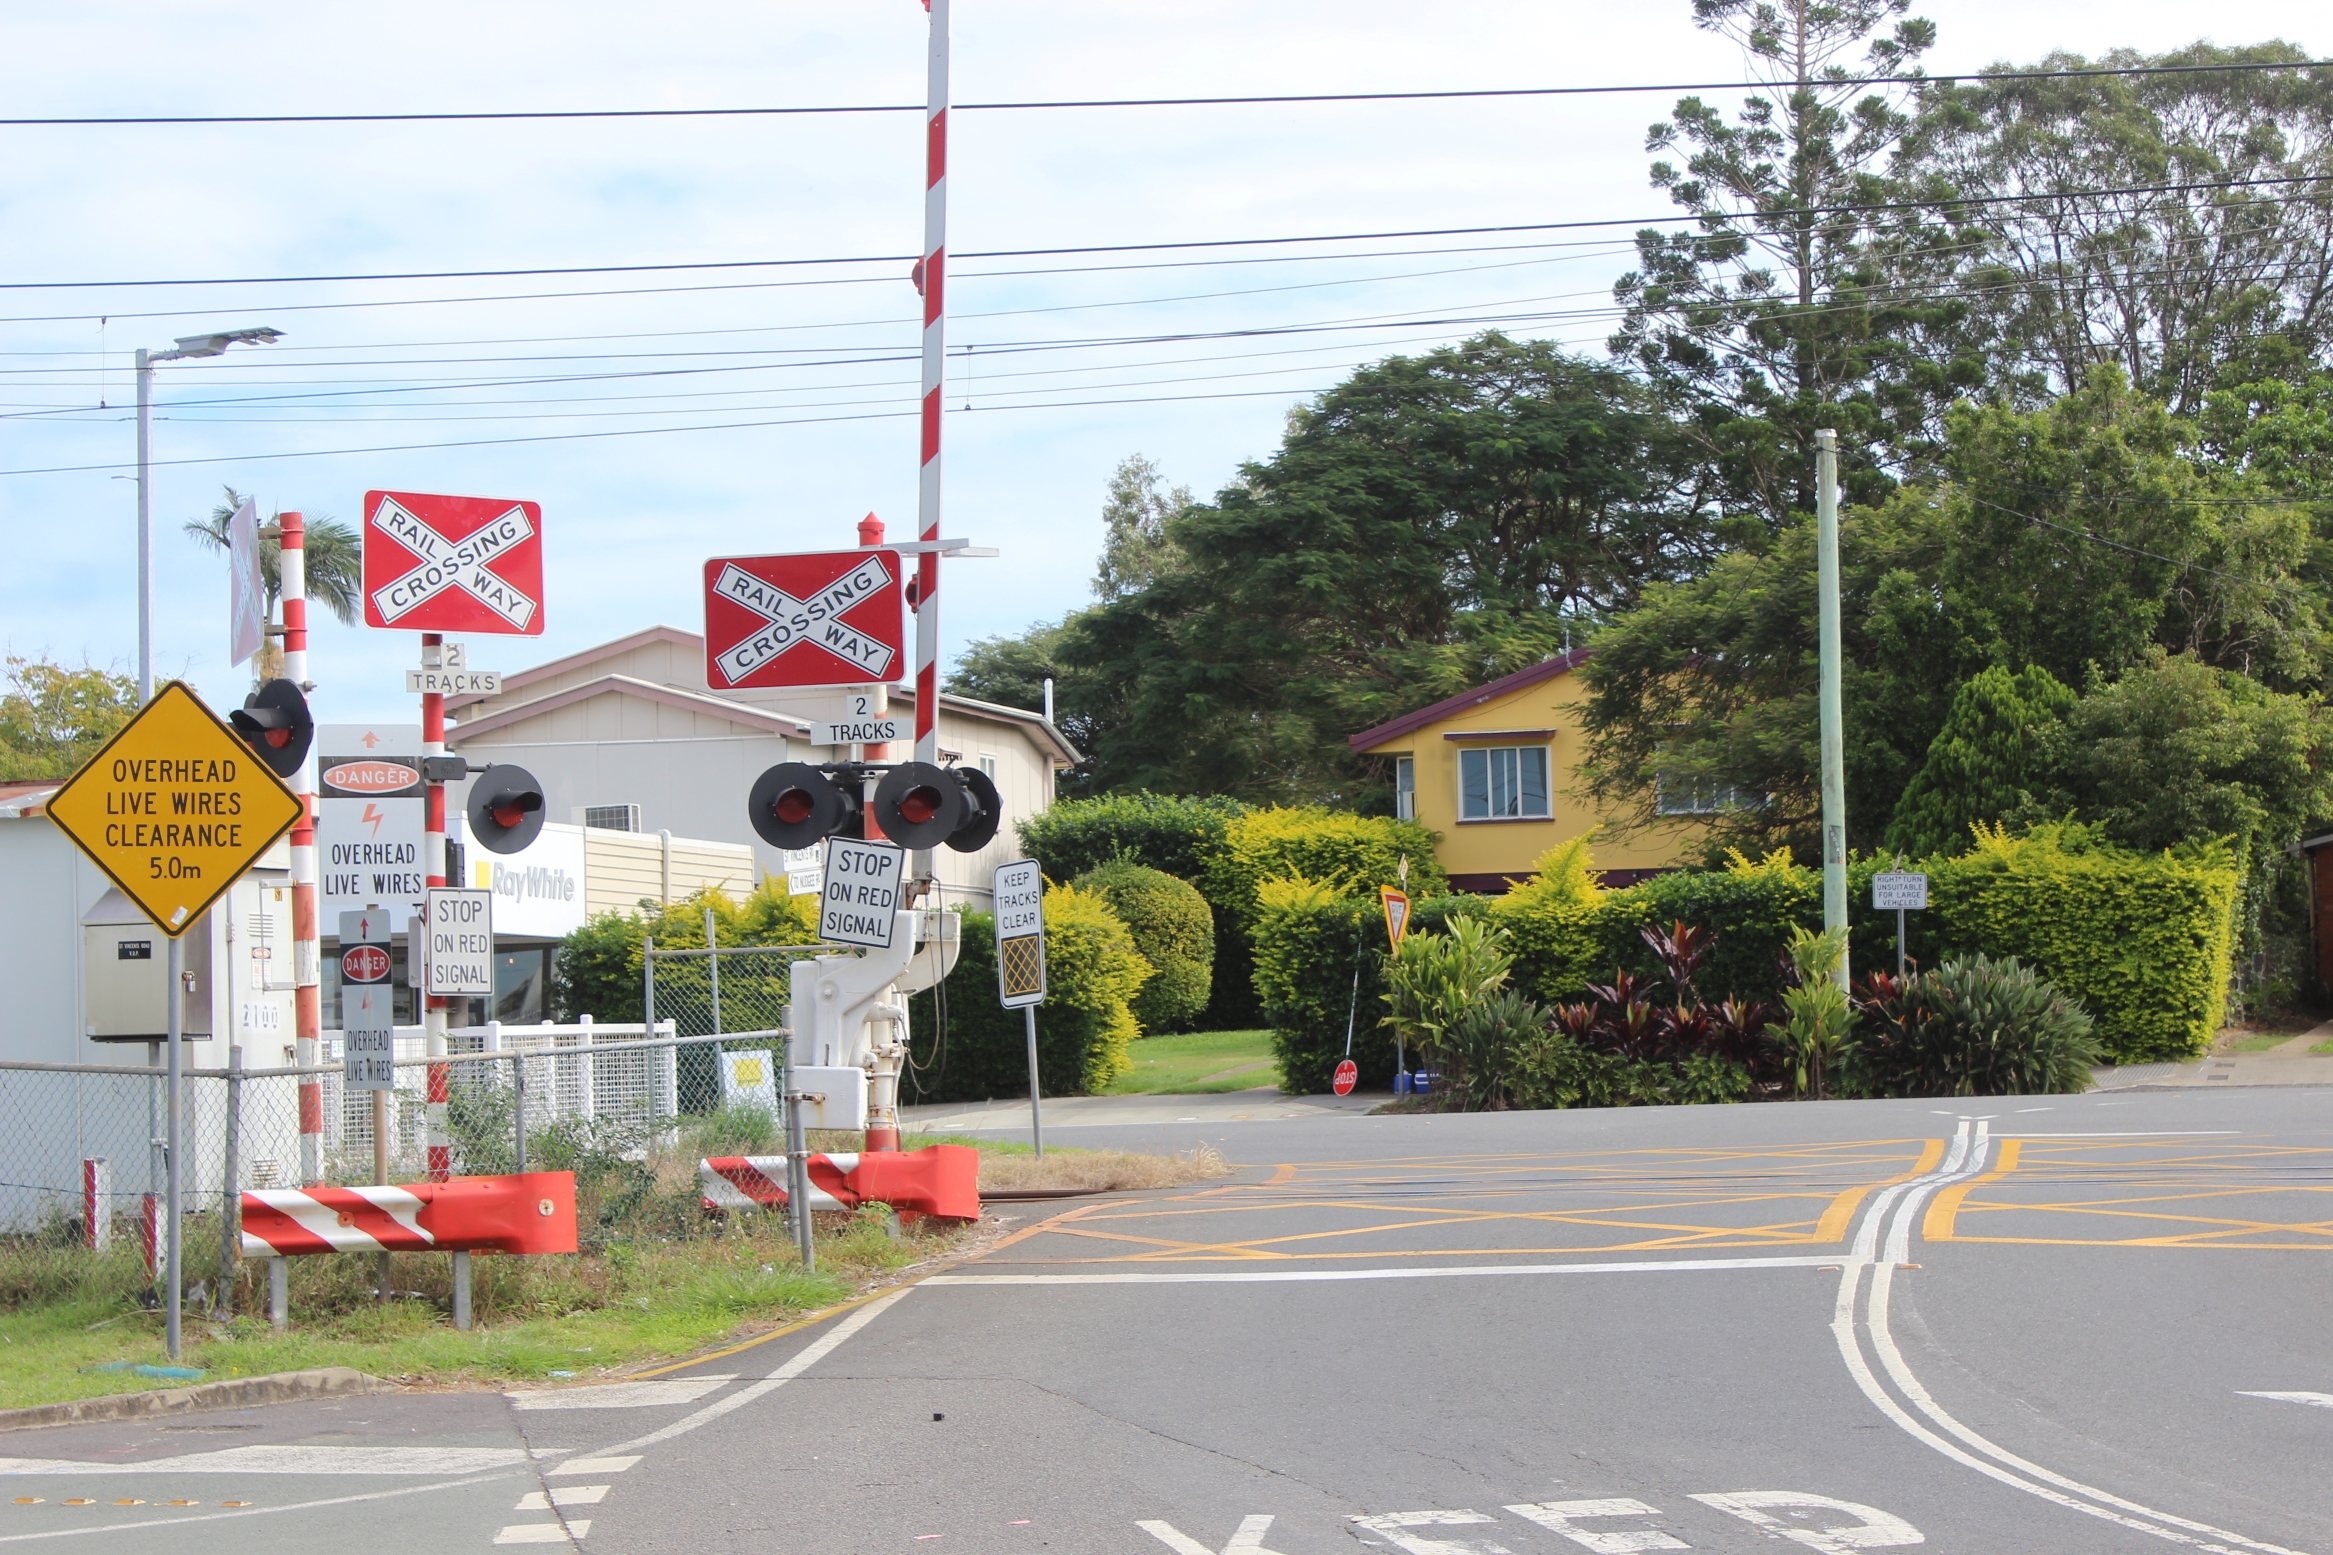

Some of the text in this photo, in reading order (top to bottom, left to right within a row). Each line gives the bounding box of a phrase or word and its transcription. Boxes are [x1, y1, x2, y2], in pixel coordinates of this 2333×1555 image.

[389, 511, 437, 560] RAIL
[391, 521, 516, 607] CROSSING
[472, 571, 522, 613] WAY
[732, 576, 785, 618] RAIL
[735, 572, 872, 667] CROSSING
[825, 625, 879, 662] WAY
[446, 647, 460, 667] 2
[413, 674, 495, 690] TRACKS
[856, 697, 867, 715] 2
[830, 722, 895, 741] TRACKS
[113, 760, 236, 783] OVERHEAD
[335, 770, 410, 784] DANGER
[107, 792, 241, 815] LIVE WIRES
[105, 824, 242, 847] CLEARANCE
[332, 843, 415, 865] OVERHEAD
[838, 850, 892, 877] STOP
[150, 857, 201, 879] 5.0m
[326, 873, 421, 895] LIVE WIRES
[1003, 871, 1030, 888] KEEP
[1876, 883, 1923, 891] UNSUITABLE
[829, 881, 892, 908] ON RED
[998, 890, 1038, 909] TRACKS
[1896, 891, 1921, 899] LARGE
[439, 900, 482, 922] STOP
[1003, 912, 1036, 929] CLEAR
[826, 911, 886, 938] SIGNAL
[434, 934, 488, 953] ON RED
[346, 956, 386, 971] DANGER
[435, 965, 488, 984] SIGNAL
[347, 1030, 389, 1052] OVERHEAD
[346, 1058, 391, 1081] LIVE WIRES
[1334, 1071, 1356, 1085] STOP
